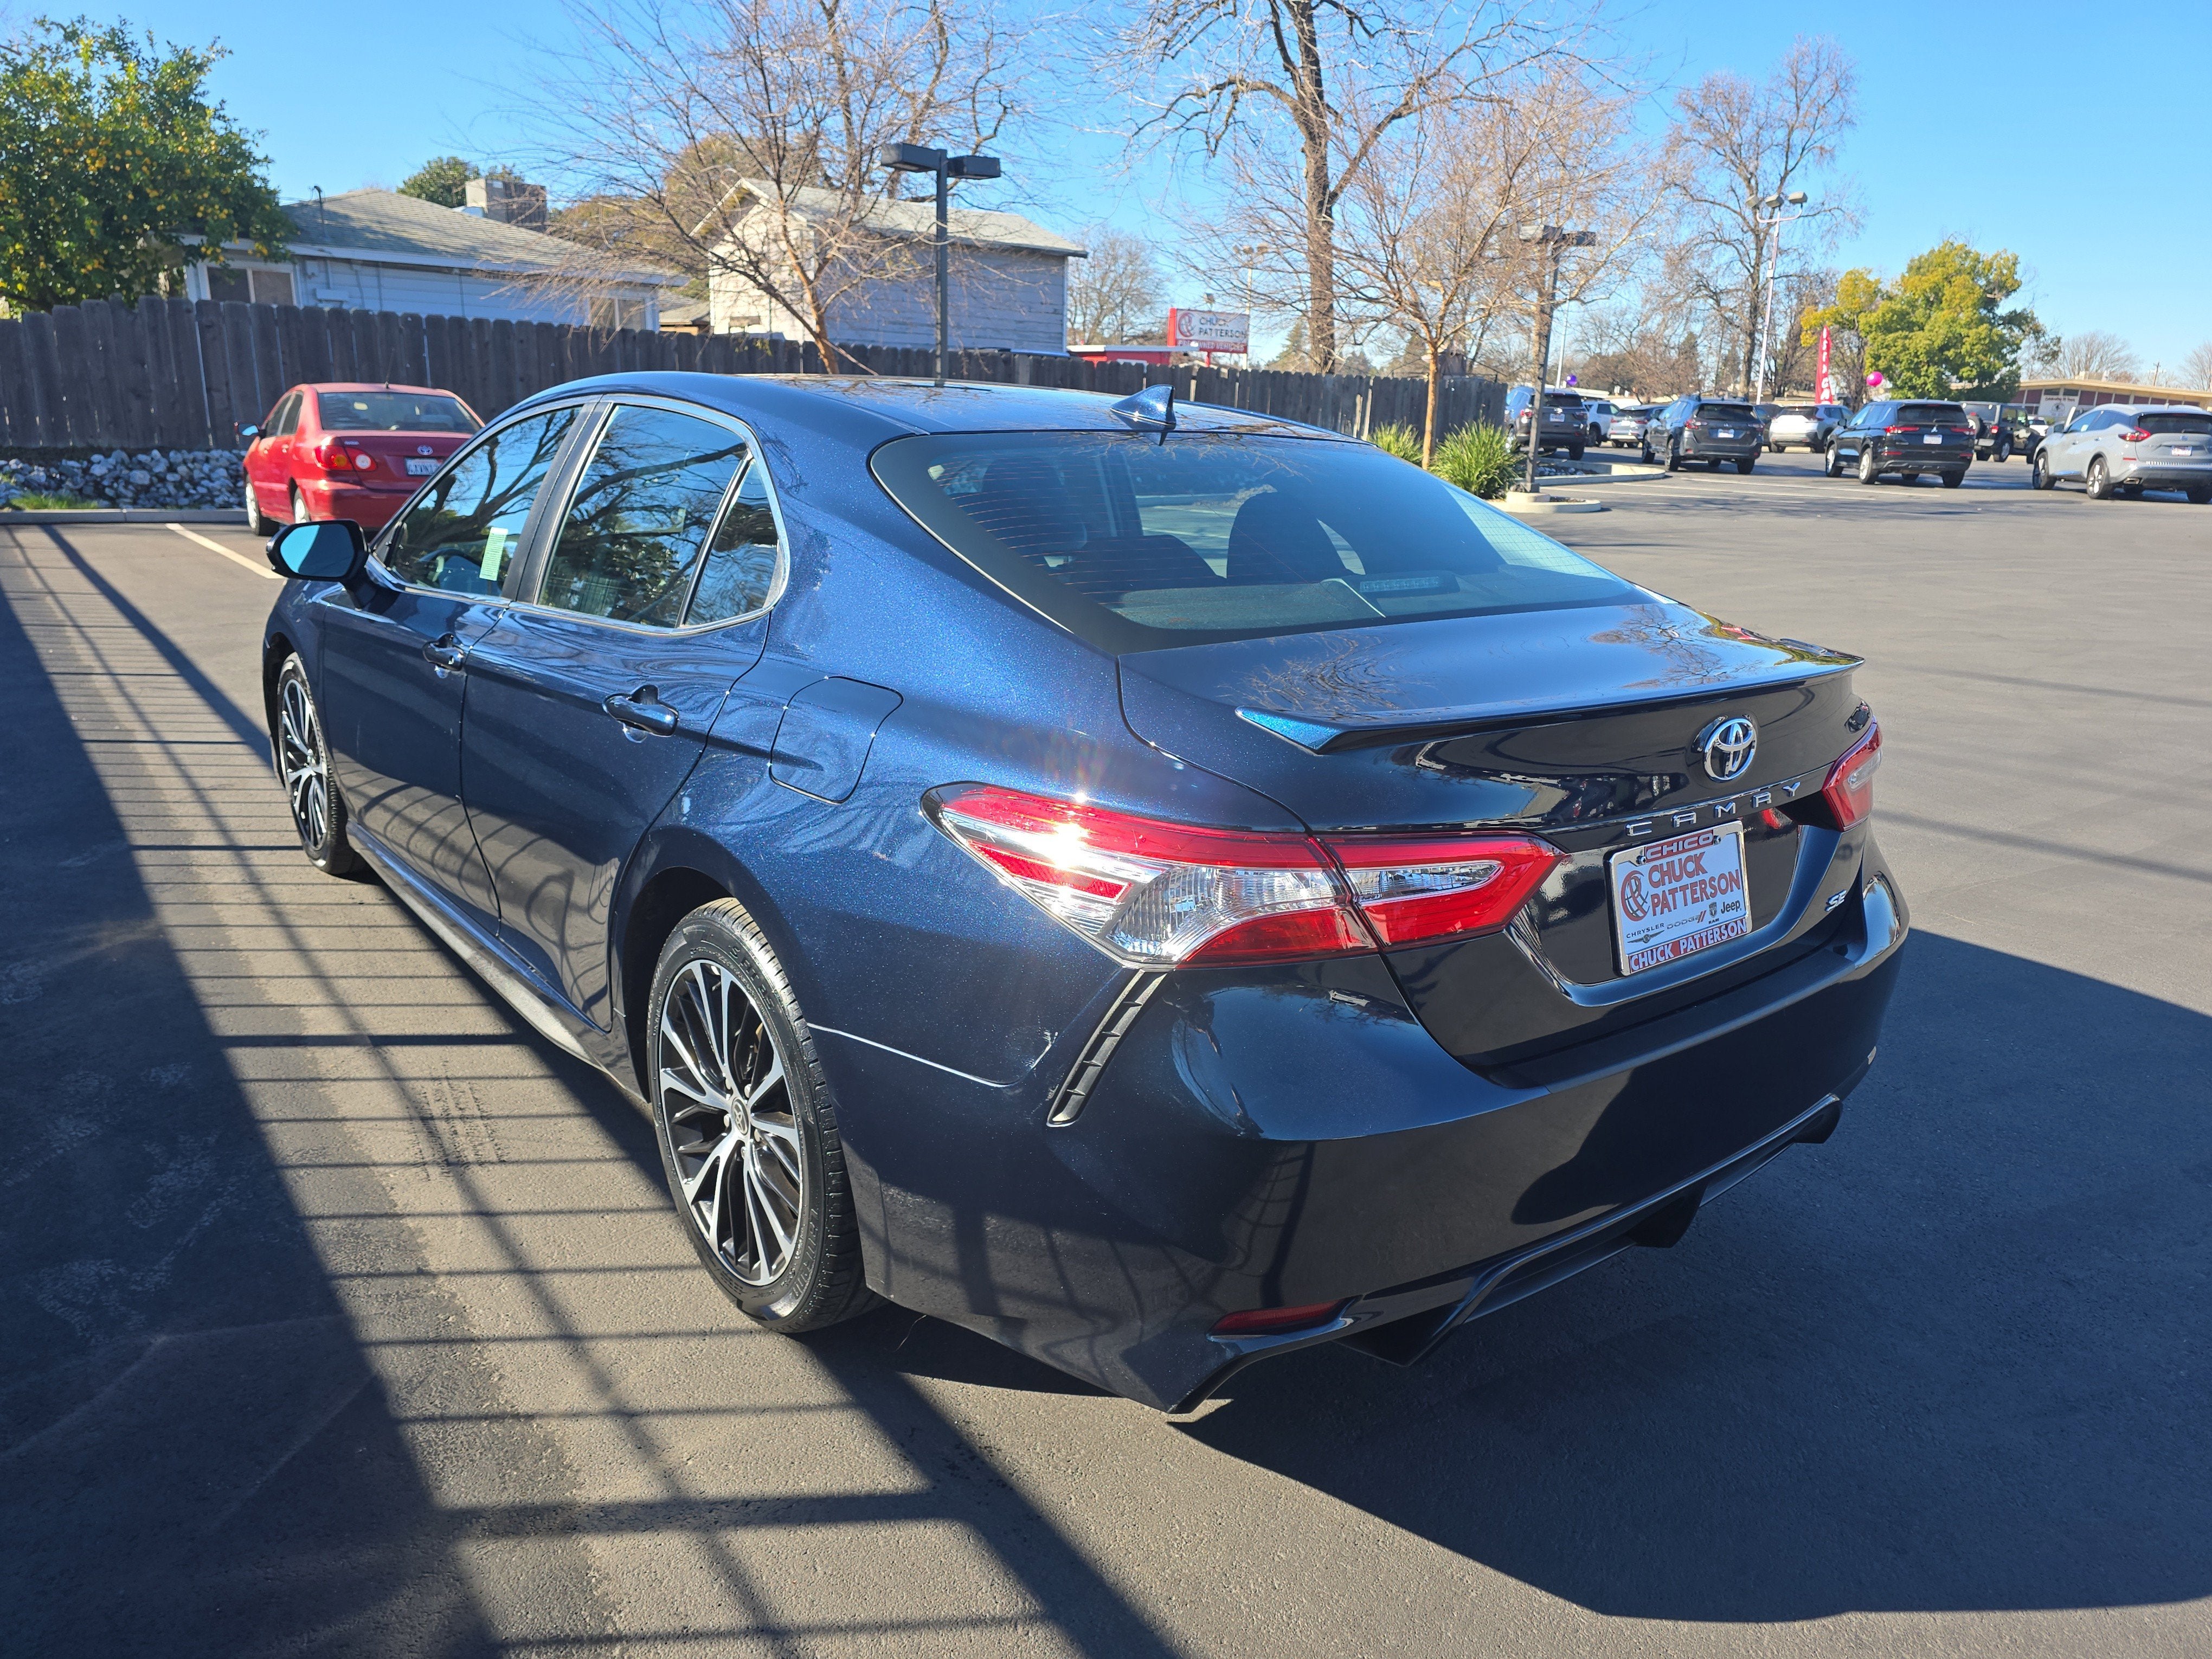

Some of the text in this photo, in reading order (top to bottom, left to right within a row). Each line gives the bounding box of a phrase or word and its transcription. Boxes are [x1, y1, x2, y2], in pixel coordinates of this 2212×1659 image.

[1626, 781, 1801, 836] CAMRY
[1646, 832, 1714, 860] CHICO
[1648, 851, 1708, 889] CHUCK
[1651, 869, 1741, 917] PATTERSON
[1826, 889, 1848, 912] SE
[1626, 922, 1665, 938] CHRYSLER
[1630, 918, 1747, 972] CHUCK PATTERSON
